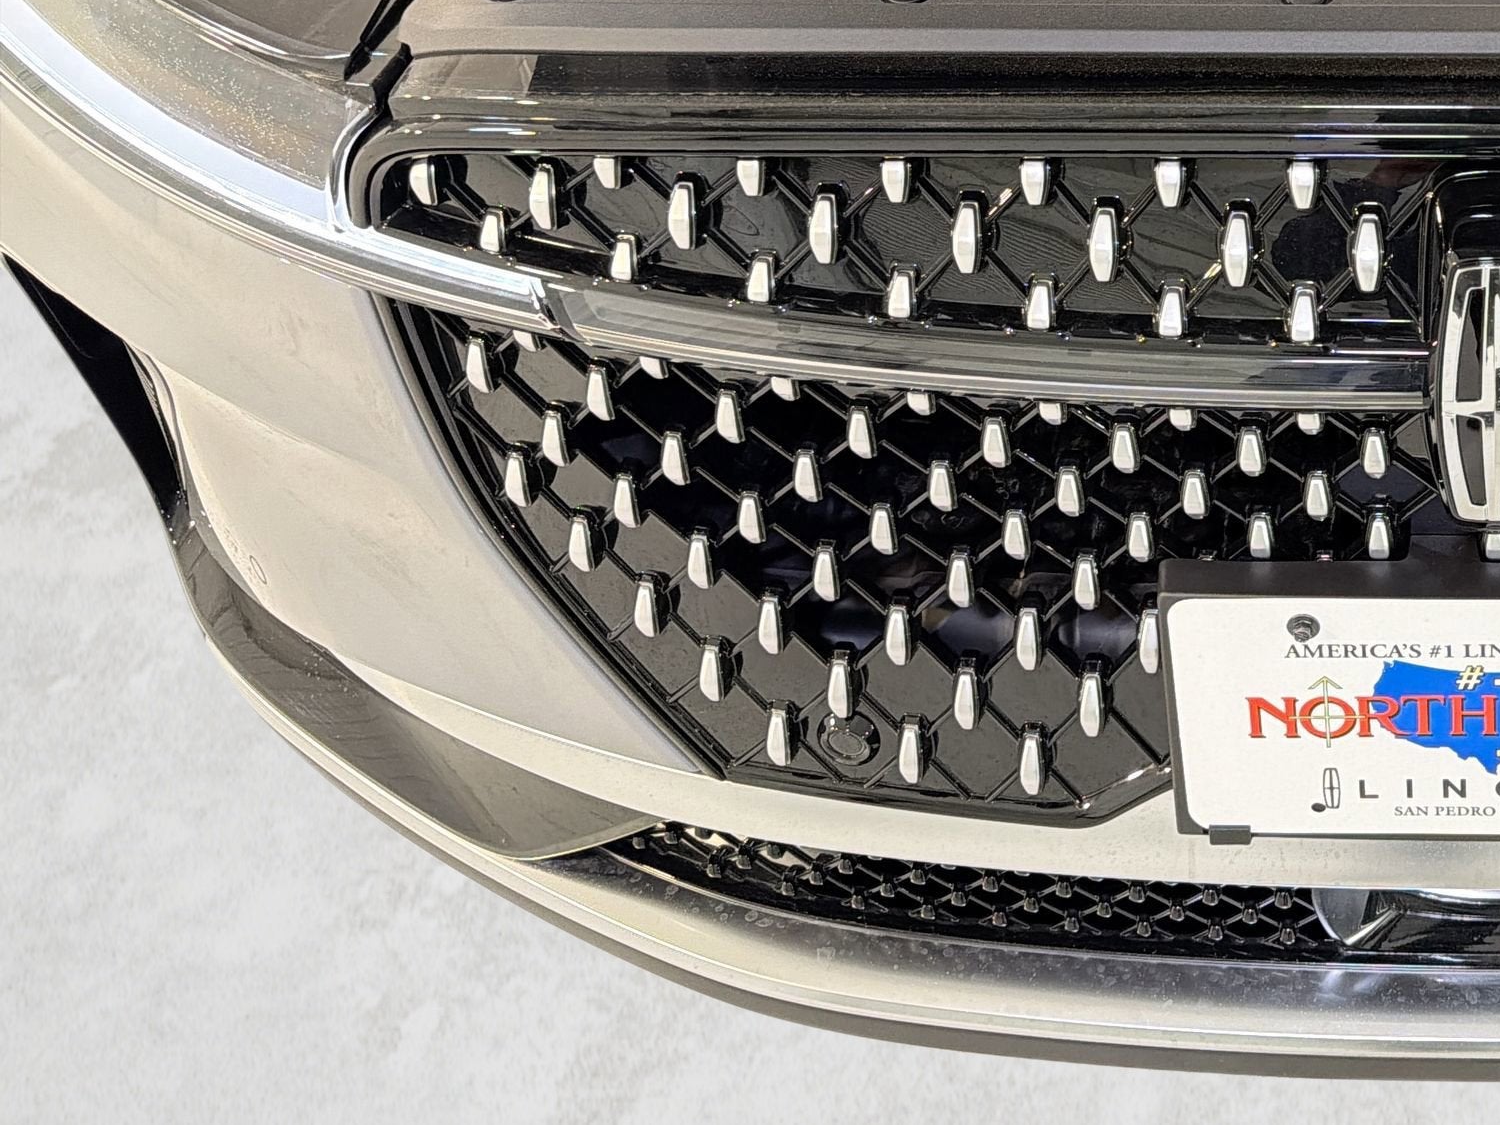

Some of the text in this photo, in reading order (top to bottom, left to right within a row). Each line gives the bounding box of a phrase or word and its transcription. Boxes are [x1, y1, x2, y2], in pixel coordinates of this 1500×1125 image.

[1284, 643, 1422, 659] AMERICA'S
[1429, 644, 1455, 659] #1
[1245, 694, 1500, 740] NORTH
[1394, 805, 1429, 817] SAN
[1435, 806, 1497, 817] PEDRO
